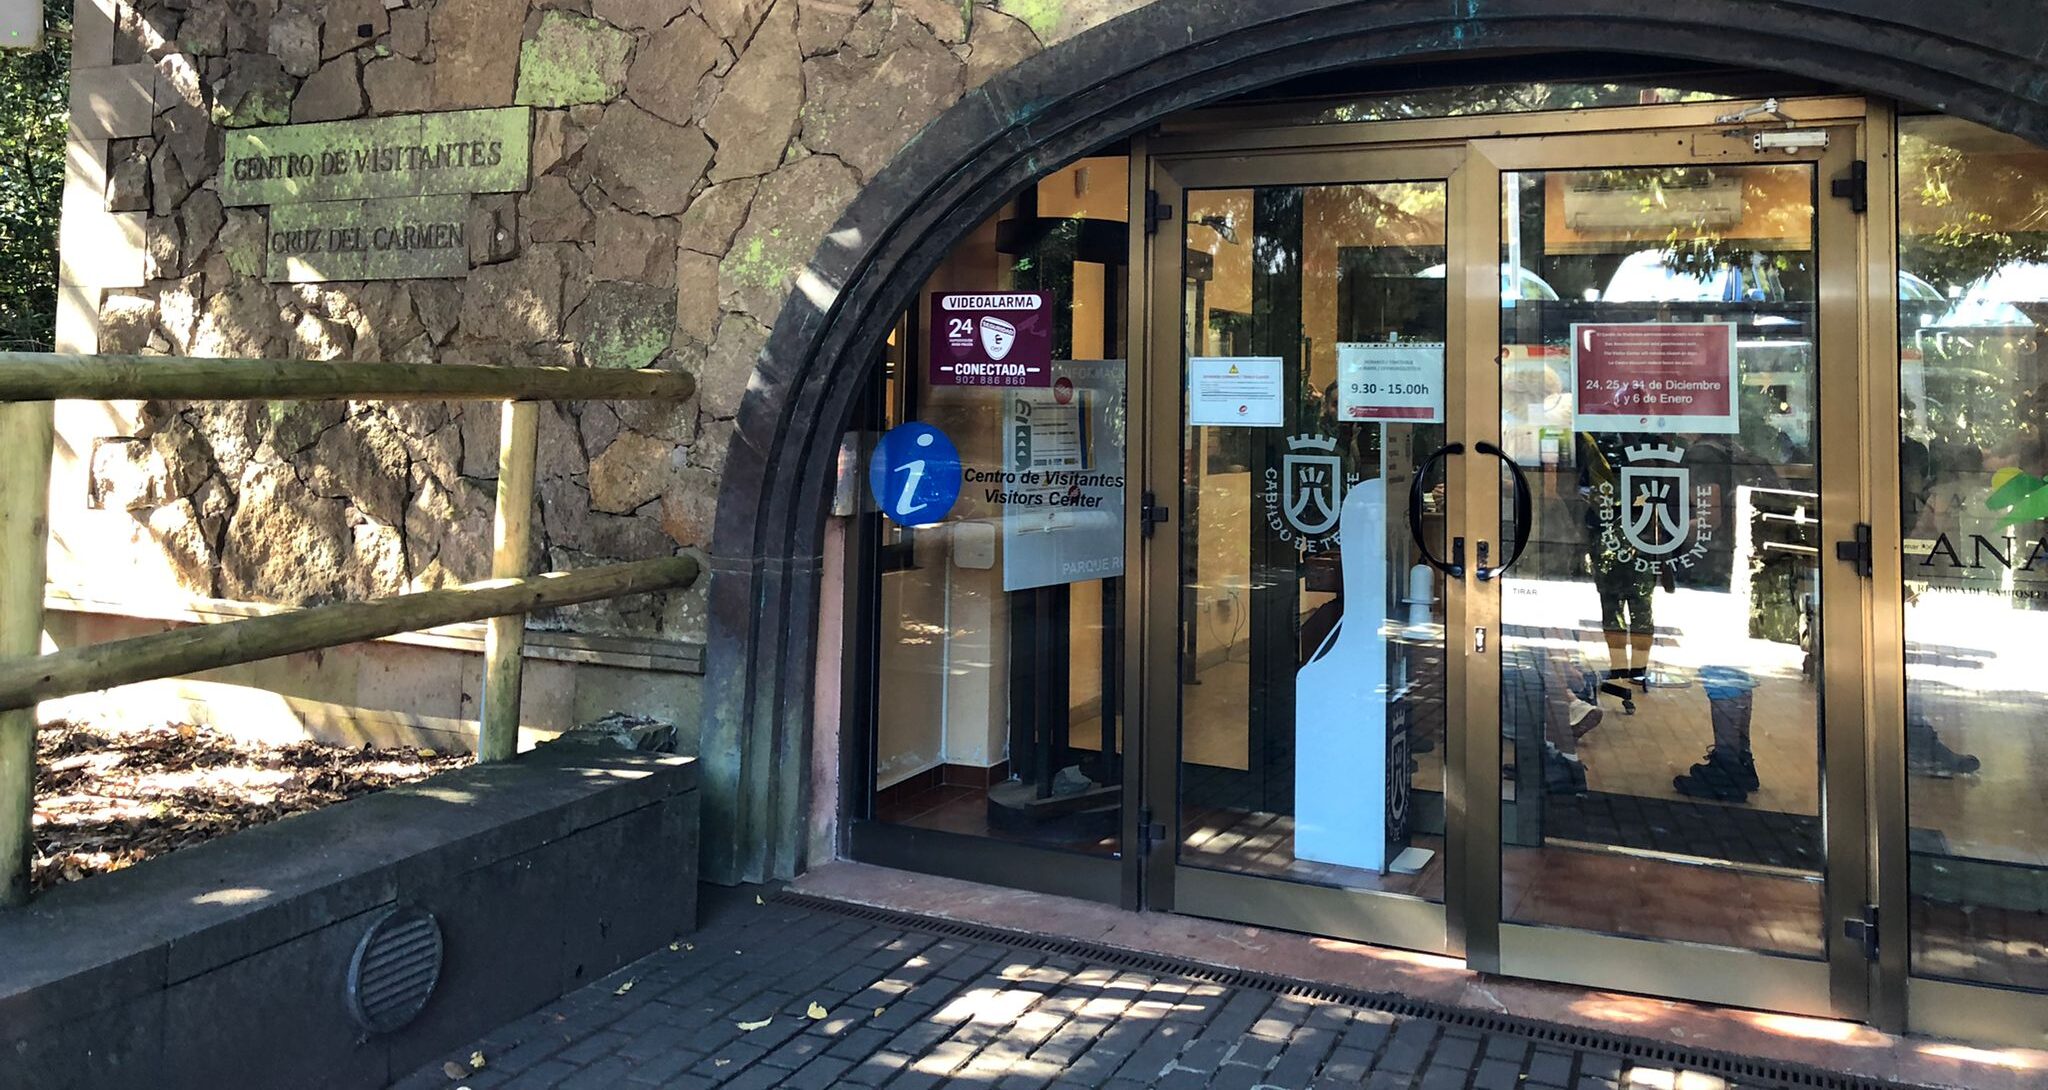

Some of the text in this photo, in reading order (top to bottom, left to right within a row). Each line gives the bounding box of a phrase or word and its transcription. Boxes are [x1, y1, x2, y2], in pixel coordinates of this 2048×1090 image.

[233, 140, 502, 181] CENTRO DE VISITANTES
[272, 222, 465, 253] CRUZ DEL CARMEN
[949, 296, 1034, 308] VIDEOALARMA
[948, 318, 974, 338] 24
[955, 363, 1026, 376] CONECTADA
[955, 376, 1026, 385] 902 886 860
[1586, 380, 1721, 393] 24, 25 y 31 de Diciembre
[1351, 383, 1377, 394] 9.30
[1387, 383, 1429, 395] 15.00h
[1623, 395, 1631, 406] y
[1633, 393, 1641, 403] 6
[1643, 393, 1657, 404] de
[1660, 393, 1693, 404] Enero
[964, 467, 1124, 487] Centro de Visitantes
[985, 488, 1043, 505] Visitors
[1049, 491, 1103, 508] Center
[1265, 467, 1292, 542] CABILDO
[1634, 557, 1663, 575] DE
[1512, 587, 1538, 596] TIRAR
